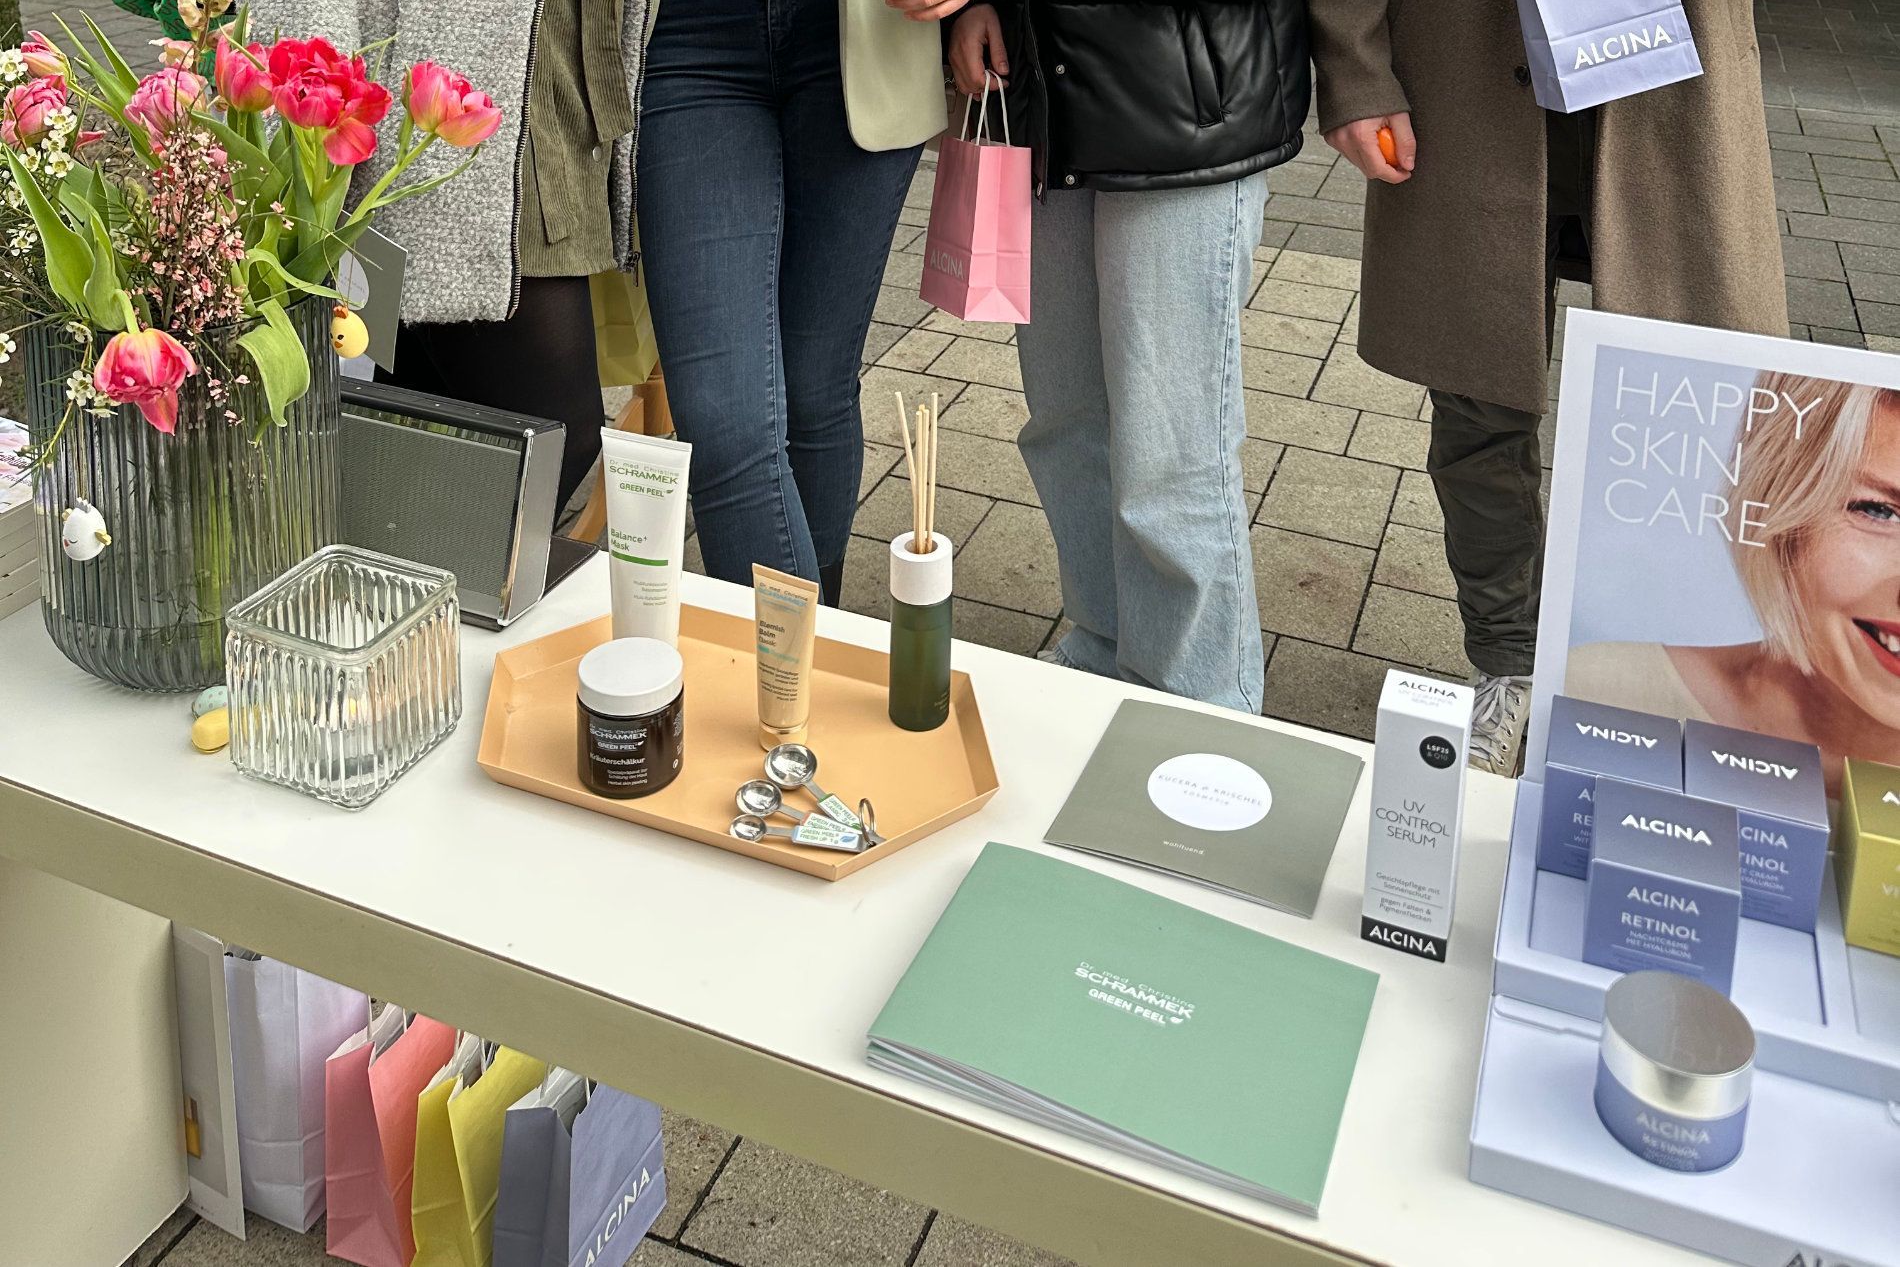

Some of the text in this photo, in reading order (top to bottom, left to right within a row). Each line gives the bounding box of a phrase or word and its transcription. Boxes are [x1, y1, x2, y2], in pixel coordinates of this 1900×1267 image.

[1573, 24, 1672, 70] ALCINA
[930, 248, 964, 281] ALCINA
[1616, 366, 1822, 440] HAPPY
[1608, 423, 1742, 486] SKIN
[609, 465, 679, 485] SCHRAMMEK
[620, 482, 645, 494] GREEN
[1604, 479, 1770, 548] CARE
[610, 538, 630, 552] Mask
[760, 620, 786, 634] Blemish
[1398, 680, 1458, 699] ALCINA
[1576, 722, 1658, 749] ALCINA
[590, 752, 646, 765] Kräuterschälkur
[1711, 750, 1799, 781] ALCINA
[1158, 774, 1197, 789] KUCERA
[1214, 788, 1262, 806] KRISCHEL
[1403, 799, 1426, 814] UV
[1375, 807, 1450, 837] CONTROL
[1387, 825, 1436, 849] SERUM
[1621, 813, 1712, 846] ALCINA
[1627, 886, 1700, 916] ALCINA
[1369, 925, 1437, 956] ALCINA
[1621, 912, 1700, 942] RETINOL
[1074, 967, 1194, 1019] SCHRAMMEK
[1088, 988, 1132, 1011] GREEN
[1138, 983, 1196, 1010] Christine
[1637, 1113, 1711, 1144] ALCINA
[584, 1166, 650, 1267] ALCINA
